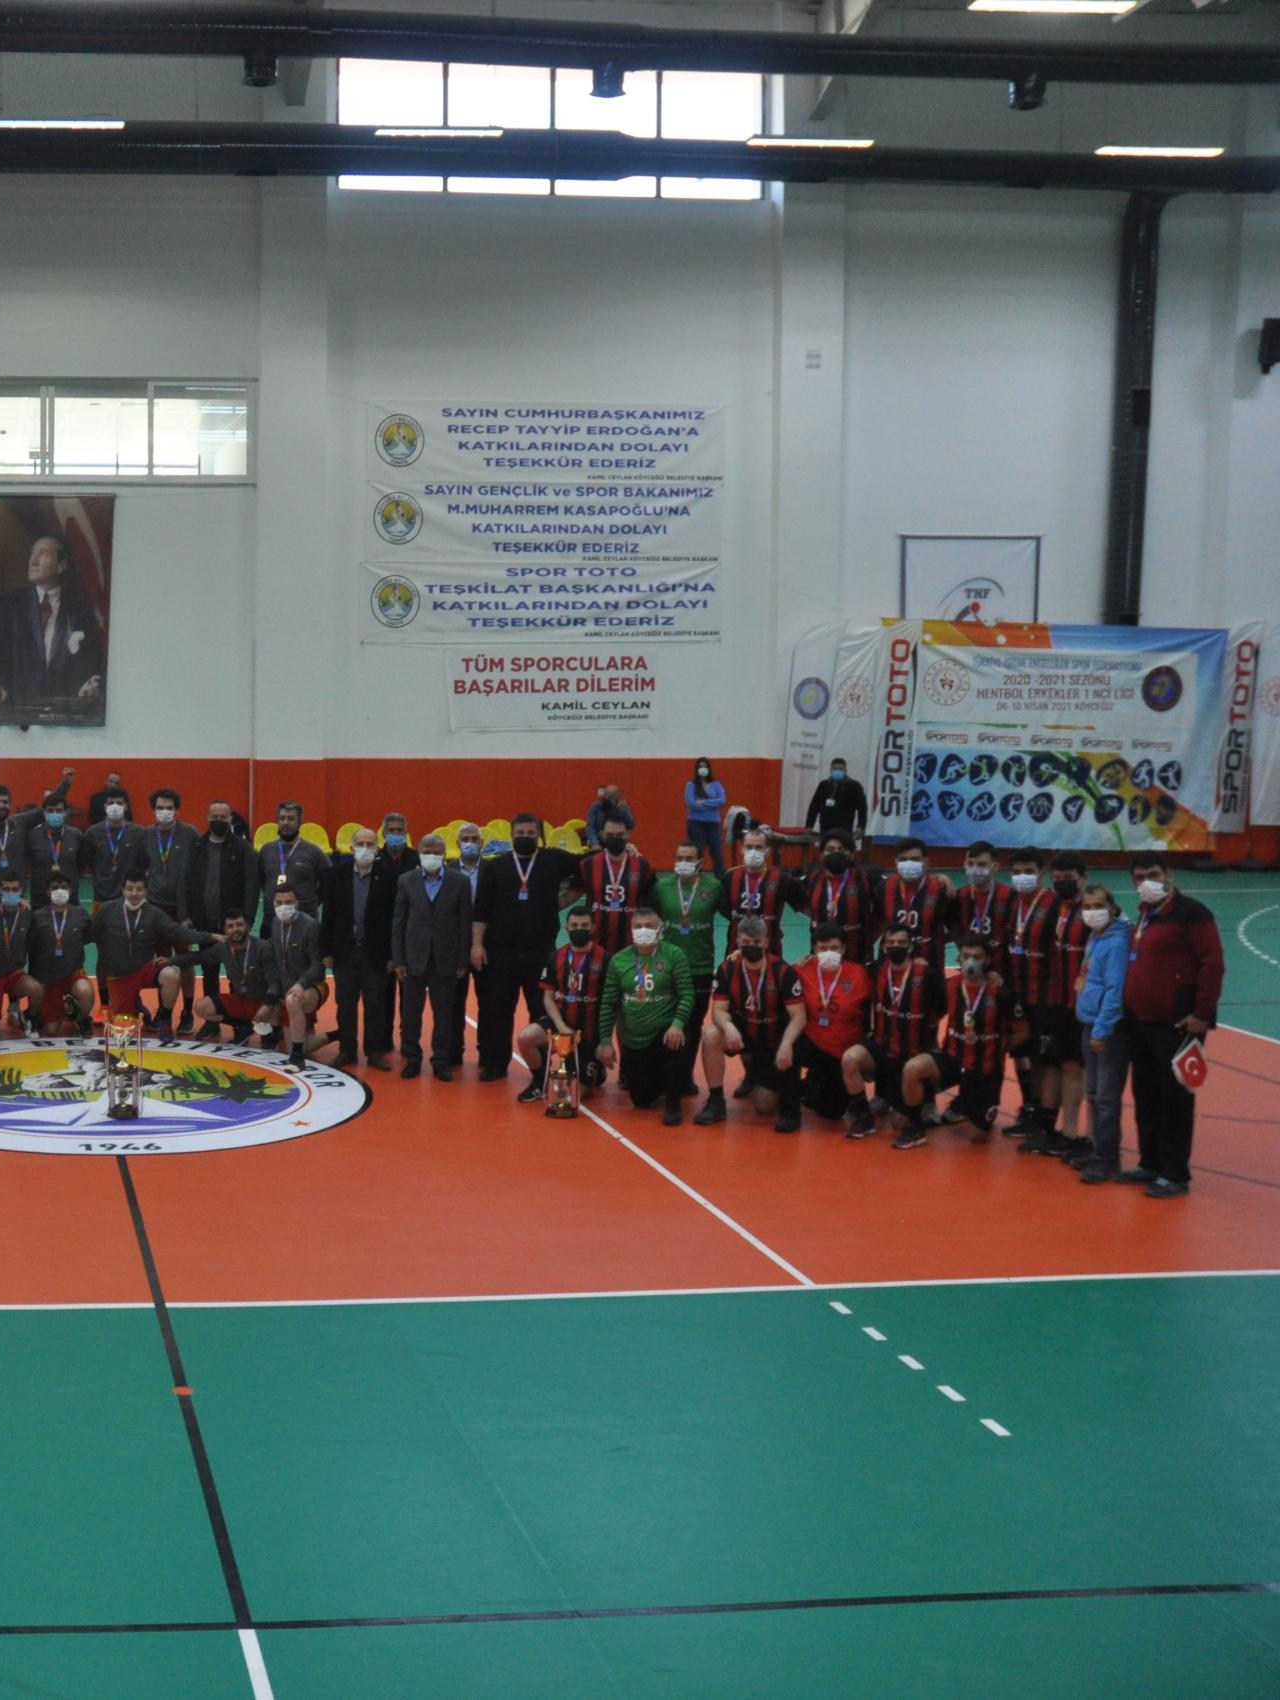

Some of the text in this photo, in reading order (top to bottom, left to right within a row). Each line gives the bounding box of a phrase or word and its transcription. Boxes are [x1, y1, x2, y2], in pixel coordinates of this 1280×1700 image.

[442, 408, 705, 422] SAYIN CUMHURBAŞKANIMIZ
[448, 424, 509, 435] RECEP
[515, 424, 580, 436] TAYYİP
[458, 441, 688, 452] KATKILARINDAN DOLAYI
[483, 456, 656, 470] TEŞEKKÜR EDERİZ
[425, 483, 713, 499] SAYIN GENÇLİK ve SPOR BAKANIMIZ
[448, 503, 559, 516] M.MUHARREM
[472, 523, 666, 535] KATKILARINDAN DOLAYI
[493, 540, 639, 556] TEŞEKKÜR EDERİZ
[506, 567, 637, 577] SPOR TOTO
[425, 581, 532, 596] TEŞKİLAT
[963, 588, 992, 599] THF
[433, 599, 707, 611] KATKILARINDAN DOLAYI
[468, 614, 674, 629] TEŞEKKÜR EDERİZ
[461, 655, 647, 673] TÜM SPORCULARA
[454, 673, 656, 696] BAŞARILAR DİLERİM
[1070, 674, 1112, 686] SEZONU
[977, 687, 1024, 699] HENTBOL
[1028, 687, 1080, 700] ERKEKLER
[542, 701, 650, 711] KAMİL CEYLAN
[605, 884, 625, 902] 53
[78, 1143, 163, 1151] 1946
